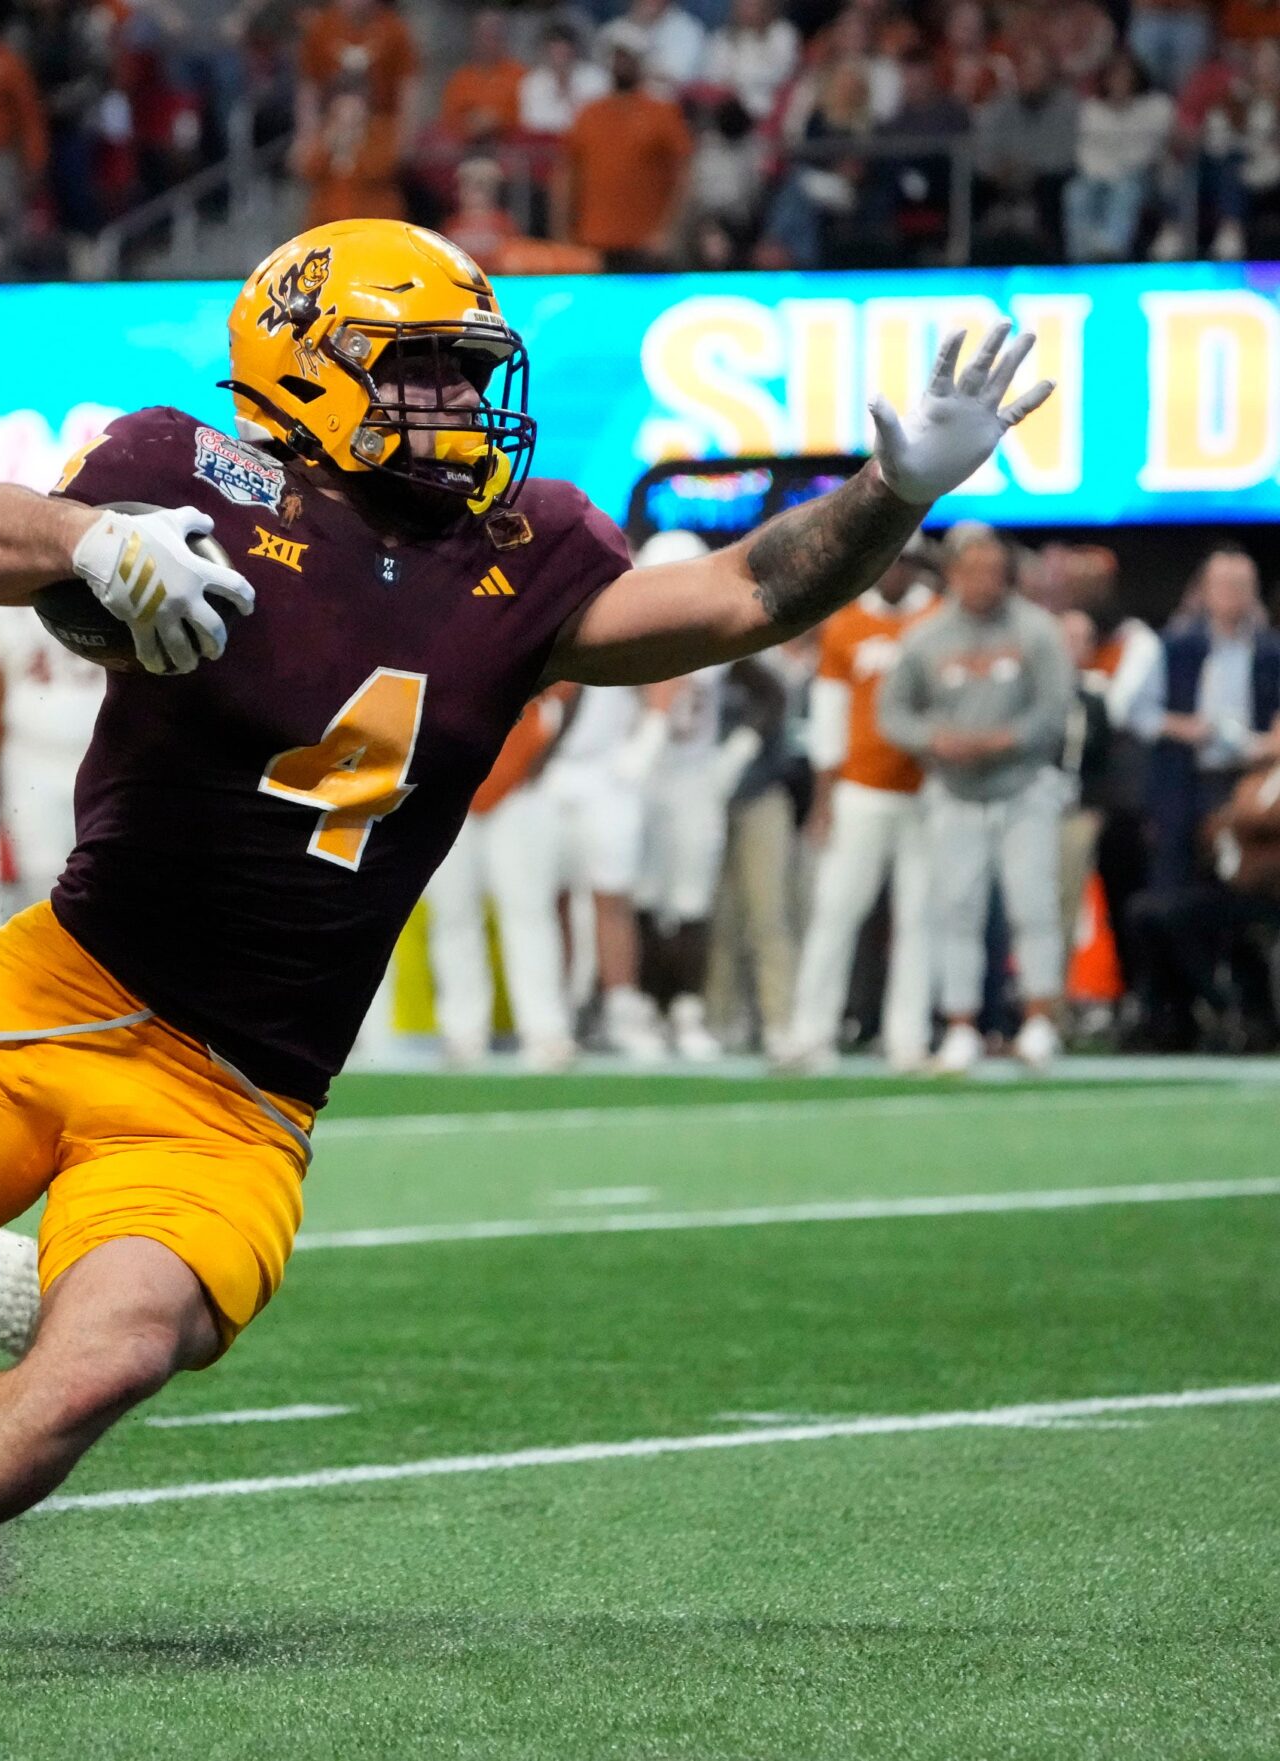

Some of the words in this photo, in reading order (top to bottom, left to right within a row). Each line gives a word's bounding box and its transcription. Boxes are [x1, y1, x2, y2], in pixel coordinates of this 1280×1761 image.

[199, 448, 279, 498] PEACH
[214, 469, 261, 496] BOWL
[247, 524, 310, 573] XII
[383, 557, 395, 568] PT
[382, 570, 394, 581] 42
[257, 666, 428, 873] 4
